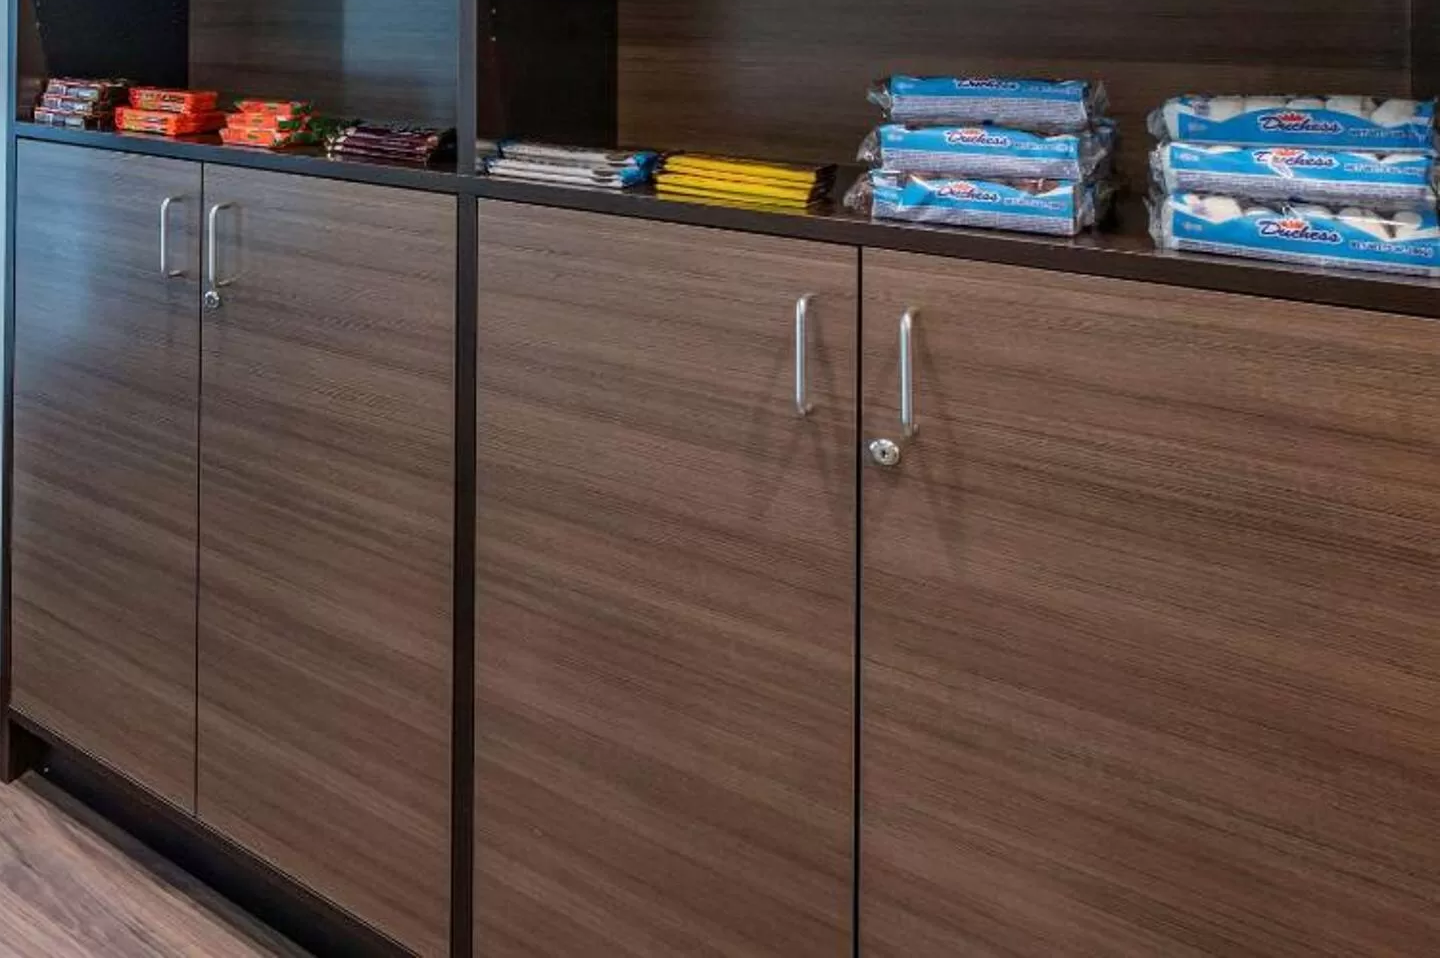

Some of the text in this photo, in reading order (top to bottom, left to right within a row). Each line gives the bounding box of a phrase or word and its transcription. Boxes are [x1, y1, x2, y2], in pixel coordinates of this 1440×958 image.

[1260, 114, 1342, 133] Duchess
[1253, 150, 1336, 168] Dchess
[1258, 219, 1341, 242] Duchess
